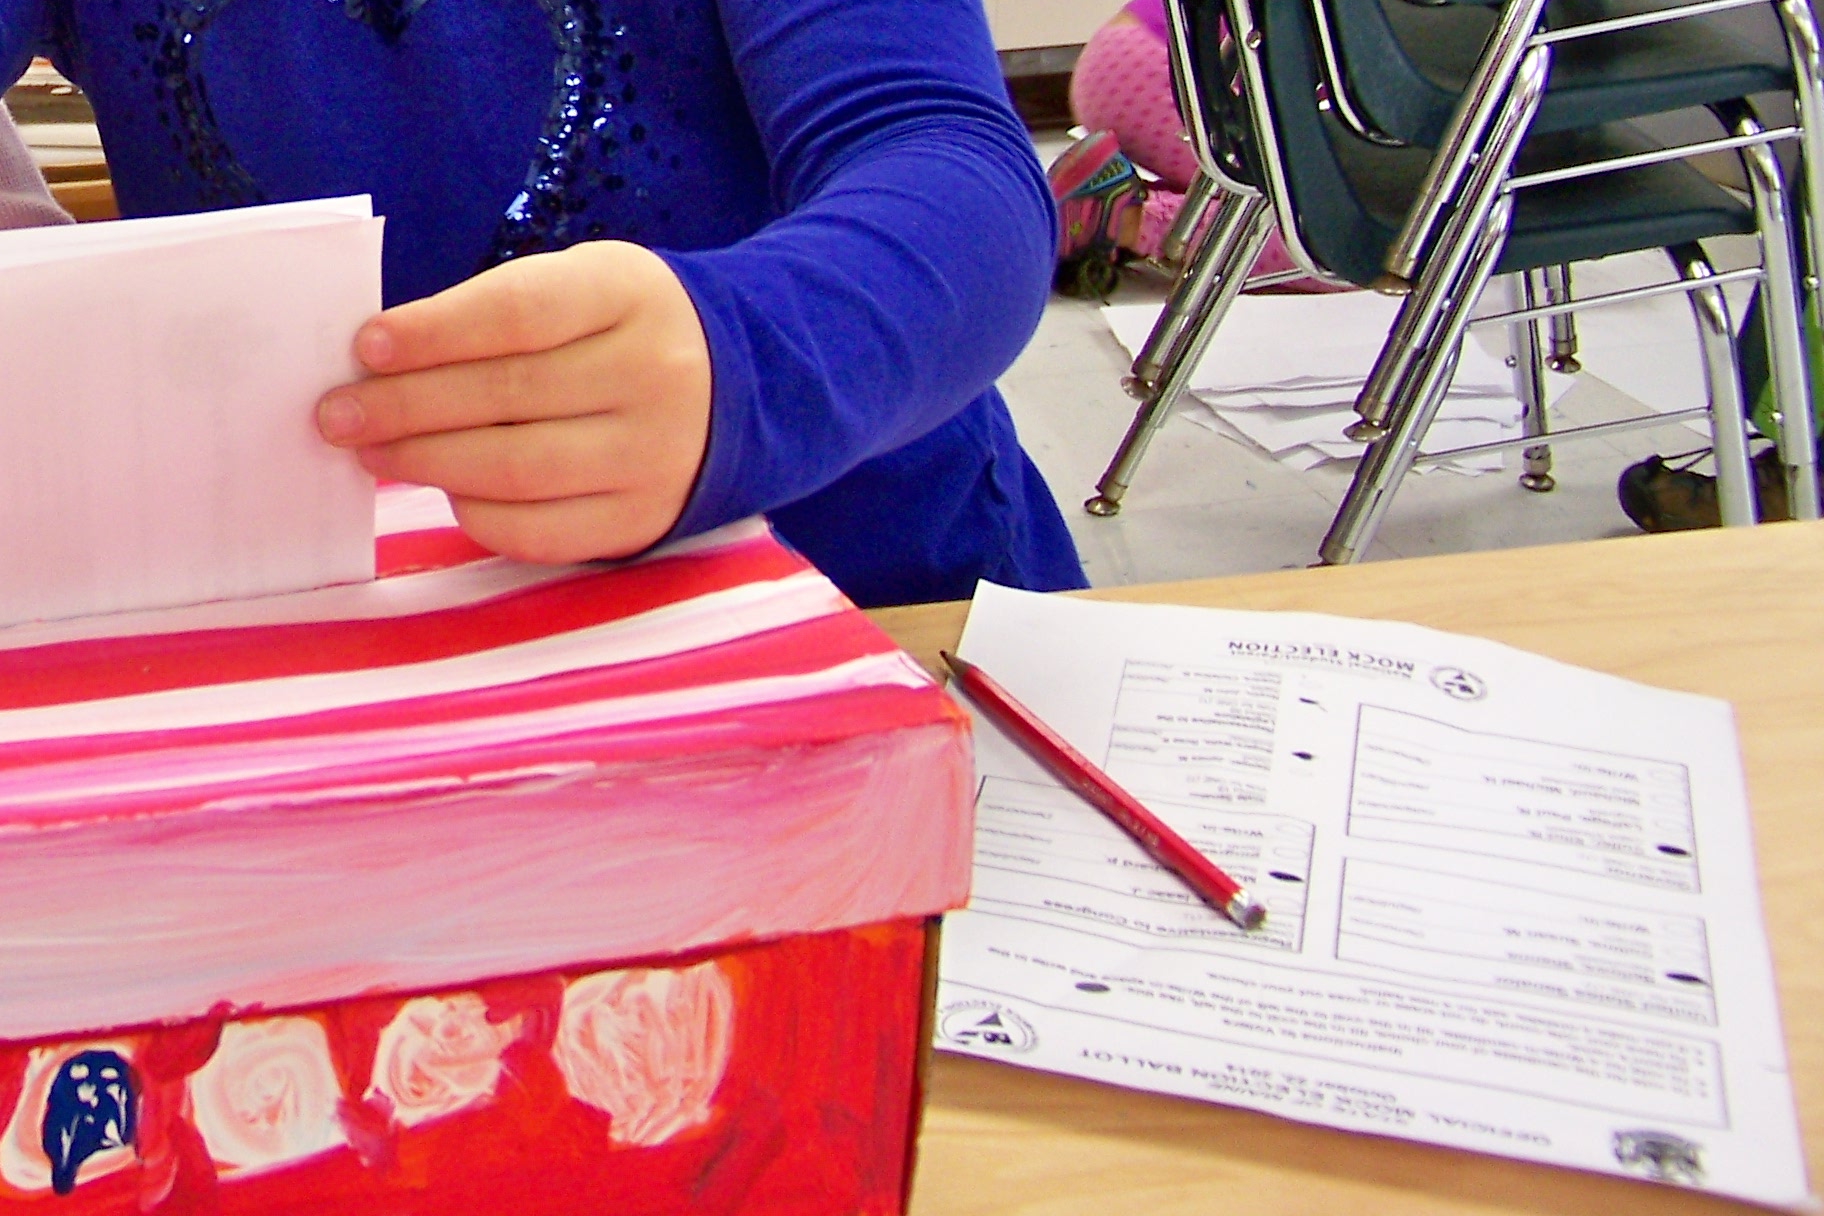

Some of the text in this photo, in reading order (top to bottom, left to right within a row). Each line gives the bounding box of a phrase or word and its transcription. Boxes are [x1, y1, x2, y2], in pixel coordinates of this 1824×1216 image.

[1228, 640, 1414, 671] MOCK ELECTION
[1042, 899, 1127, 924] Congress
[1078, 1046, 1551, 1146] OFFICIAL MOCK ELECTION BALLOT
